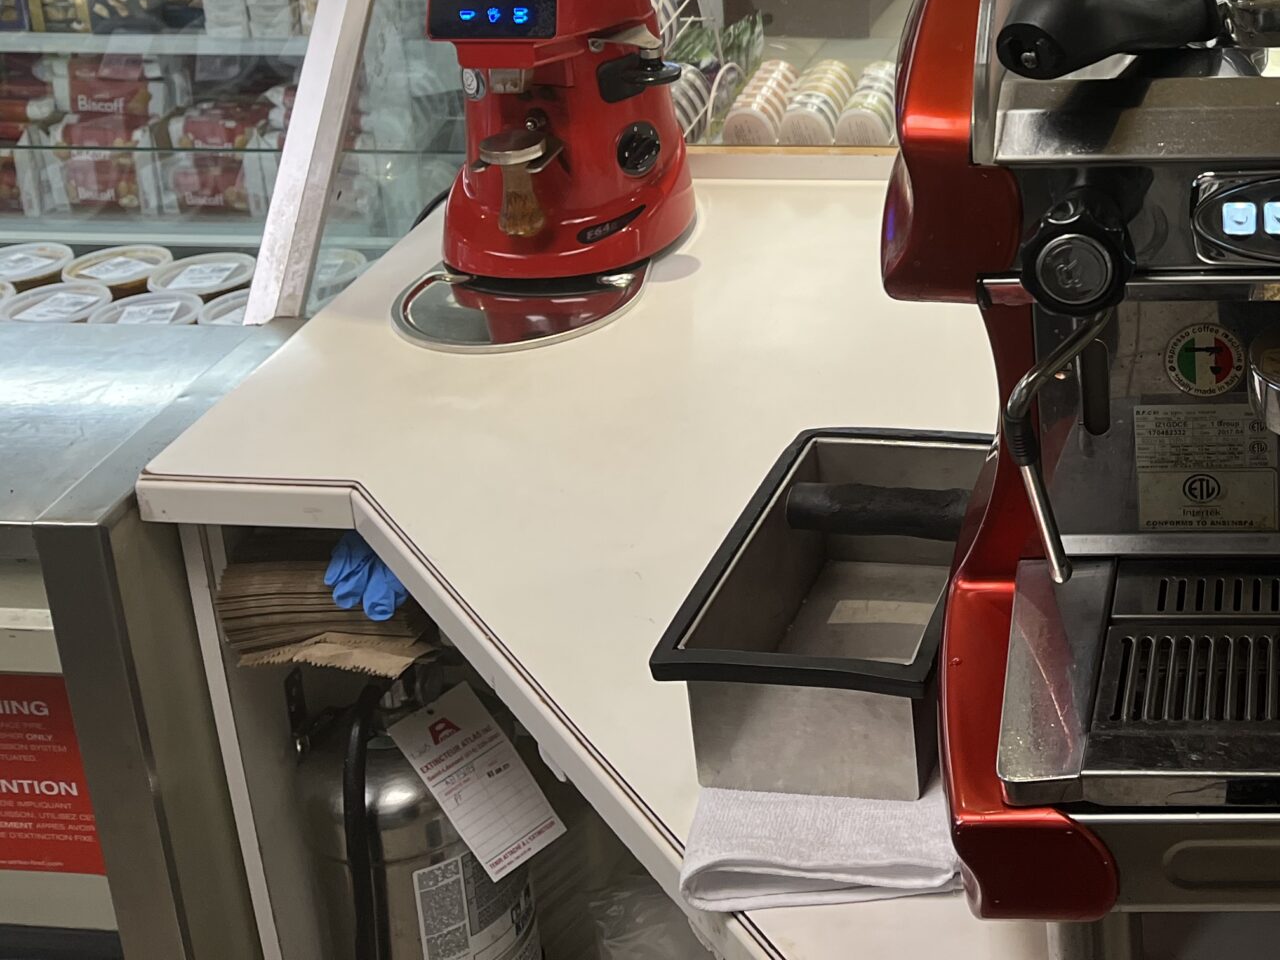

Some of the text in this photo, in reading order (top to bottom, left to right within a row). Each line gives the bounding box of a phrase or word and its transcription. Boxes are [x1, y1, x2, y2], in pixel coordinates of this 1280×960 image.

[77, 95, 124, 113] Biscoff
[78, 187, 116, 201] Biscoff
[184, 191, 224, 206] Biscoff
[1192, 325, 1219, 334] coffee
[1188, 478, 1216, 501] ETL
[1183, 508, 1221, 517] Intertek
[420, 744, 461, 774] EXTINCTEUR
[461, 731, 483, 749] ATLAS
